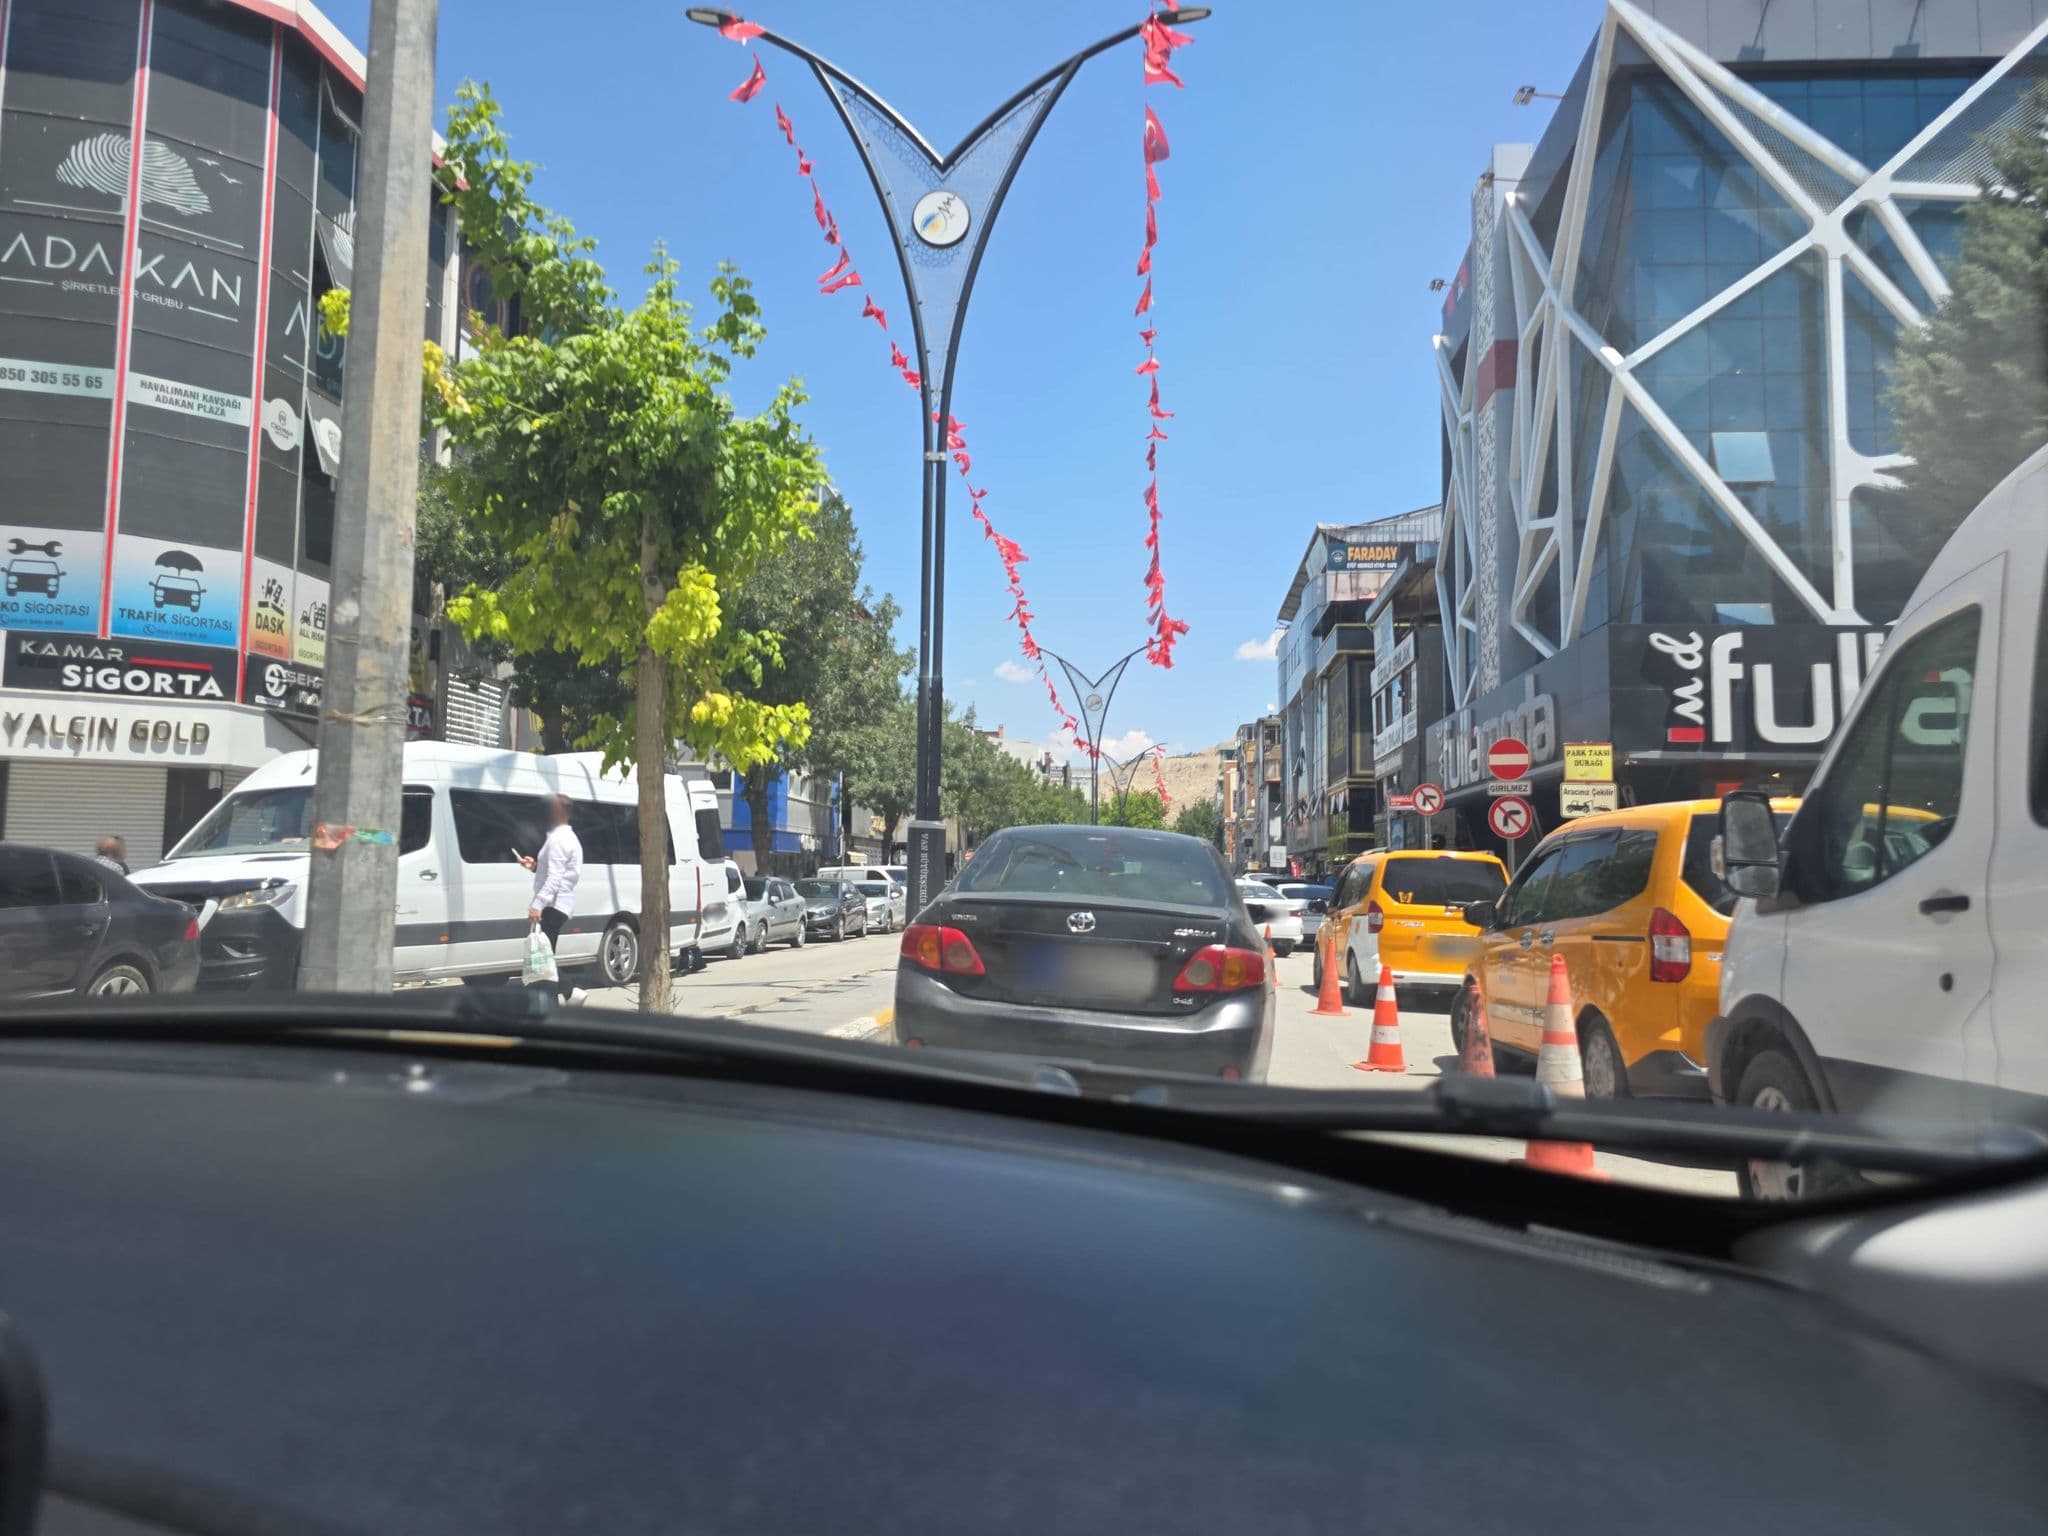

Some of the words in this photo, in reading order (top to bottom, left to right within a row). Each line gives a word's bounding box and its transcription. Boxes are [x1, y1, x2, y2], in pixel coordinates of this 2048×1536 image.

[141, 292, 184, 309] GRUBU
[0, 366, 26, 381] 850
[30, 369, 58, 385] 305
[62, 373, 81, 387] 55
[85, 375, 103, 389] 65
[155, 394, 194, 411] ADAKAN
[197, 402, 226, 417] PLAZA
[1347, 545, 1397, 561] FARADAY
[24, 601, 90, 616] SİGORTASI
[118, 607, 167, 624] TRAFİK
[171, 613, 233, 632] SİGORTASI
[255, 611, 285, 637] DASK
[20, 639, 124, 662] KAMAR
[131, 719, 210, 747] GOLD
